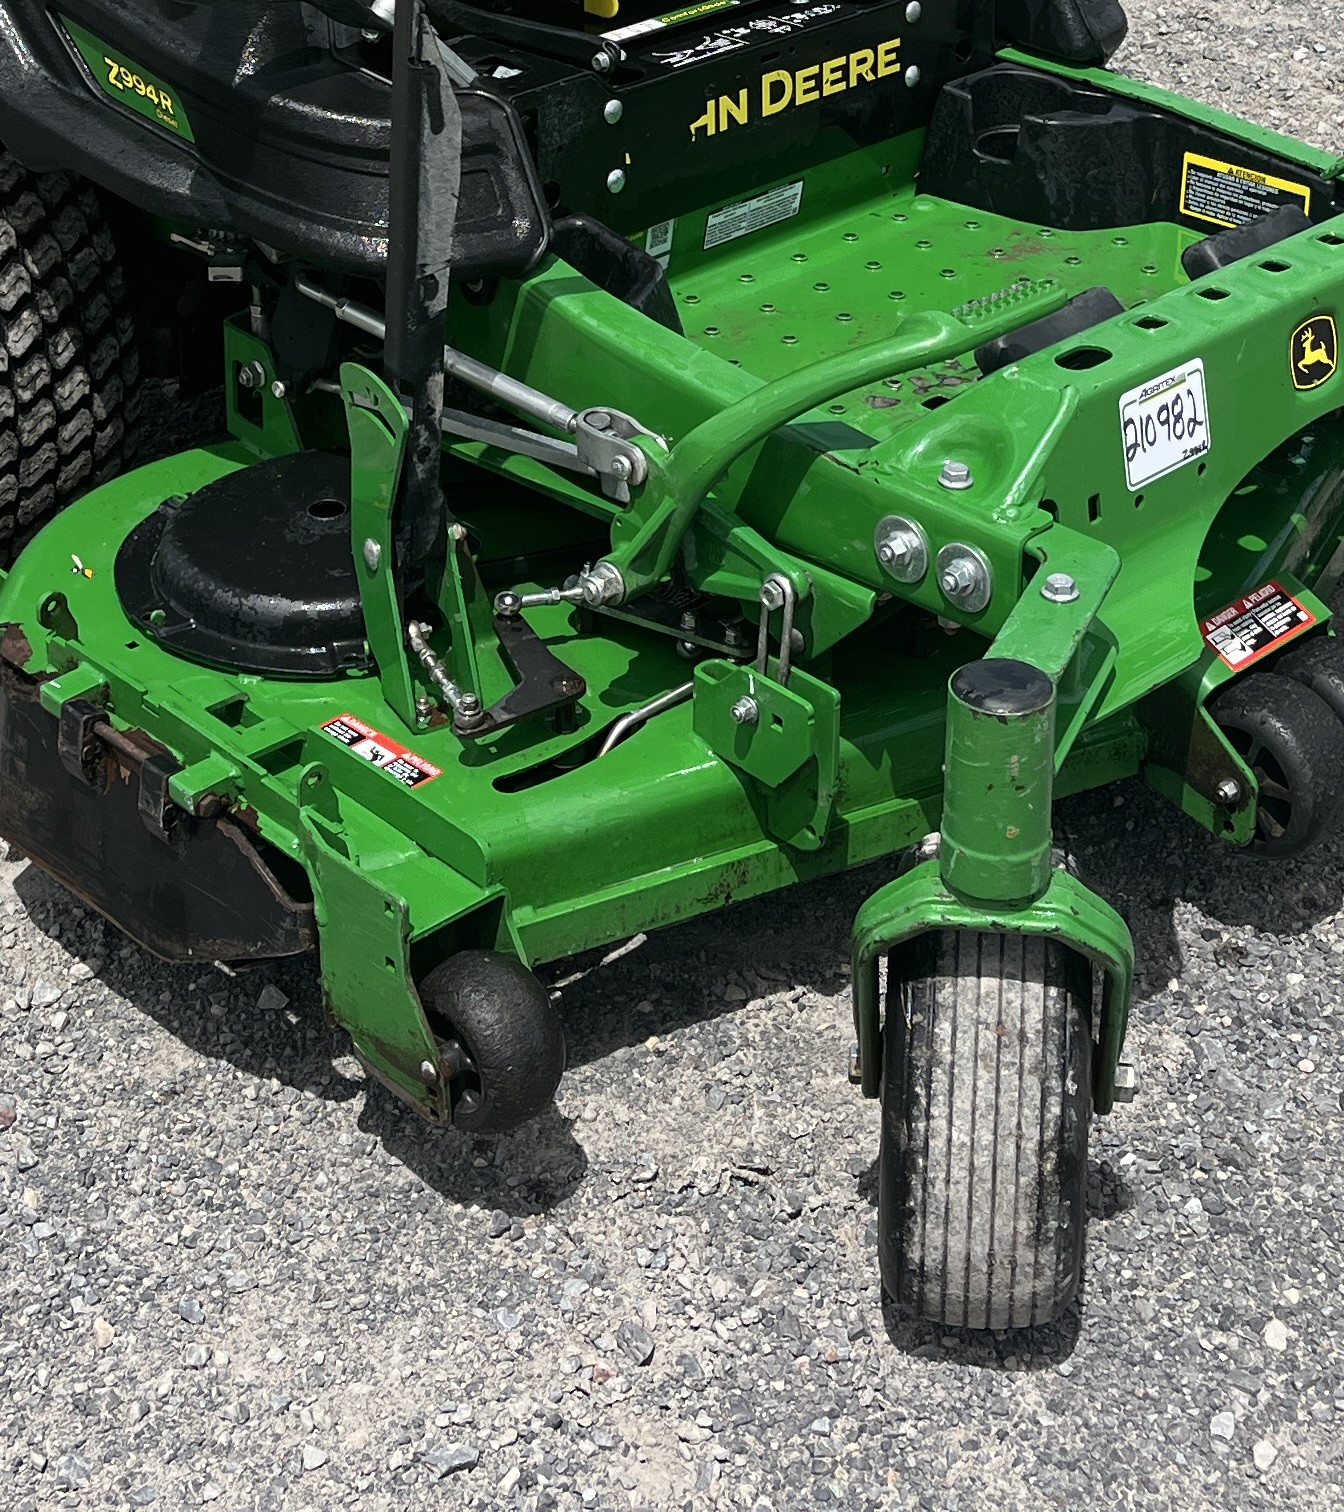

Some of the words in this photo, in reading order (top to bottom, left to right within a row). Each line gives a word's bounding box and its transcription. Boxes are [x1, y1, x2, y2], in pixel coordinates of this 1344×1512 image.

[103, 56, 174, 115] Z994R
[761, 37, 901, 118] DEERE
[1123, 388, 1204, 462] 210982
